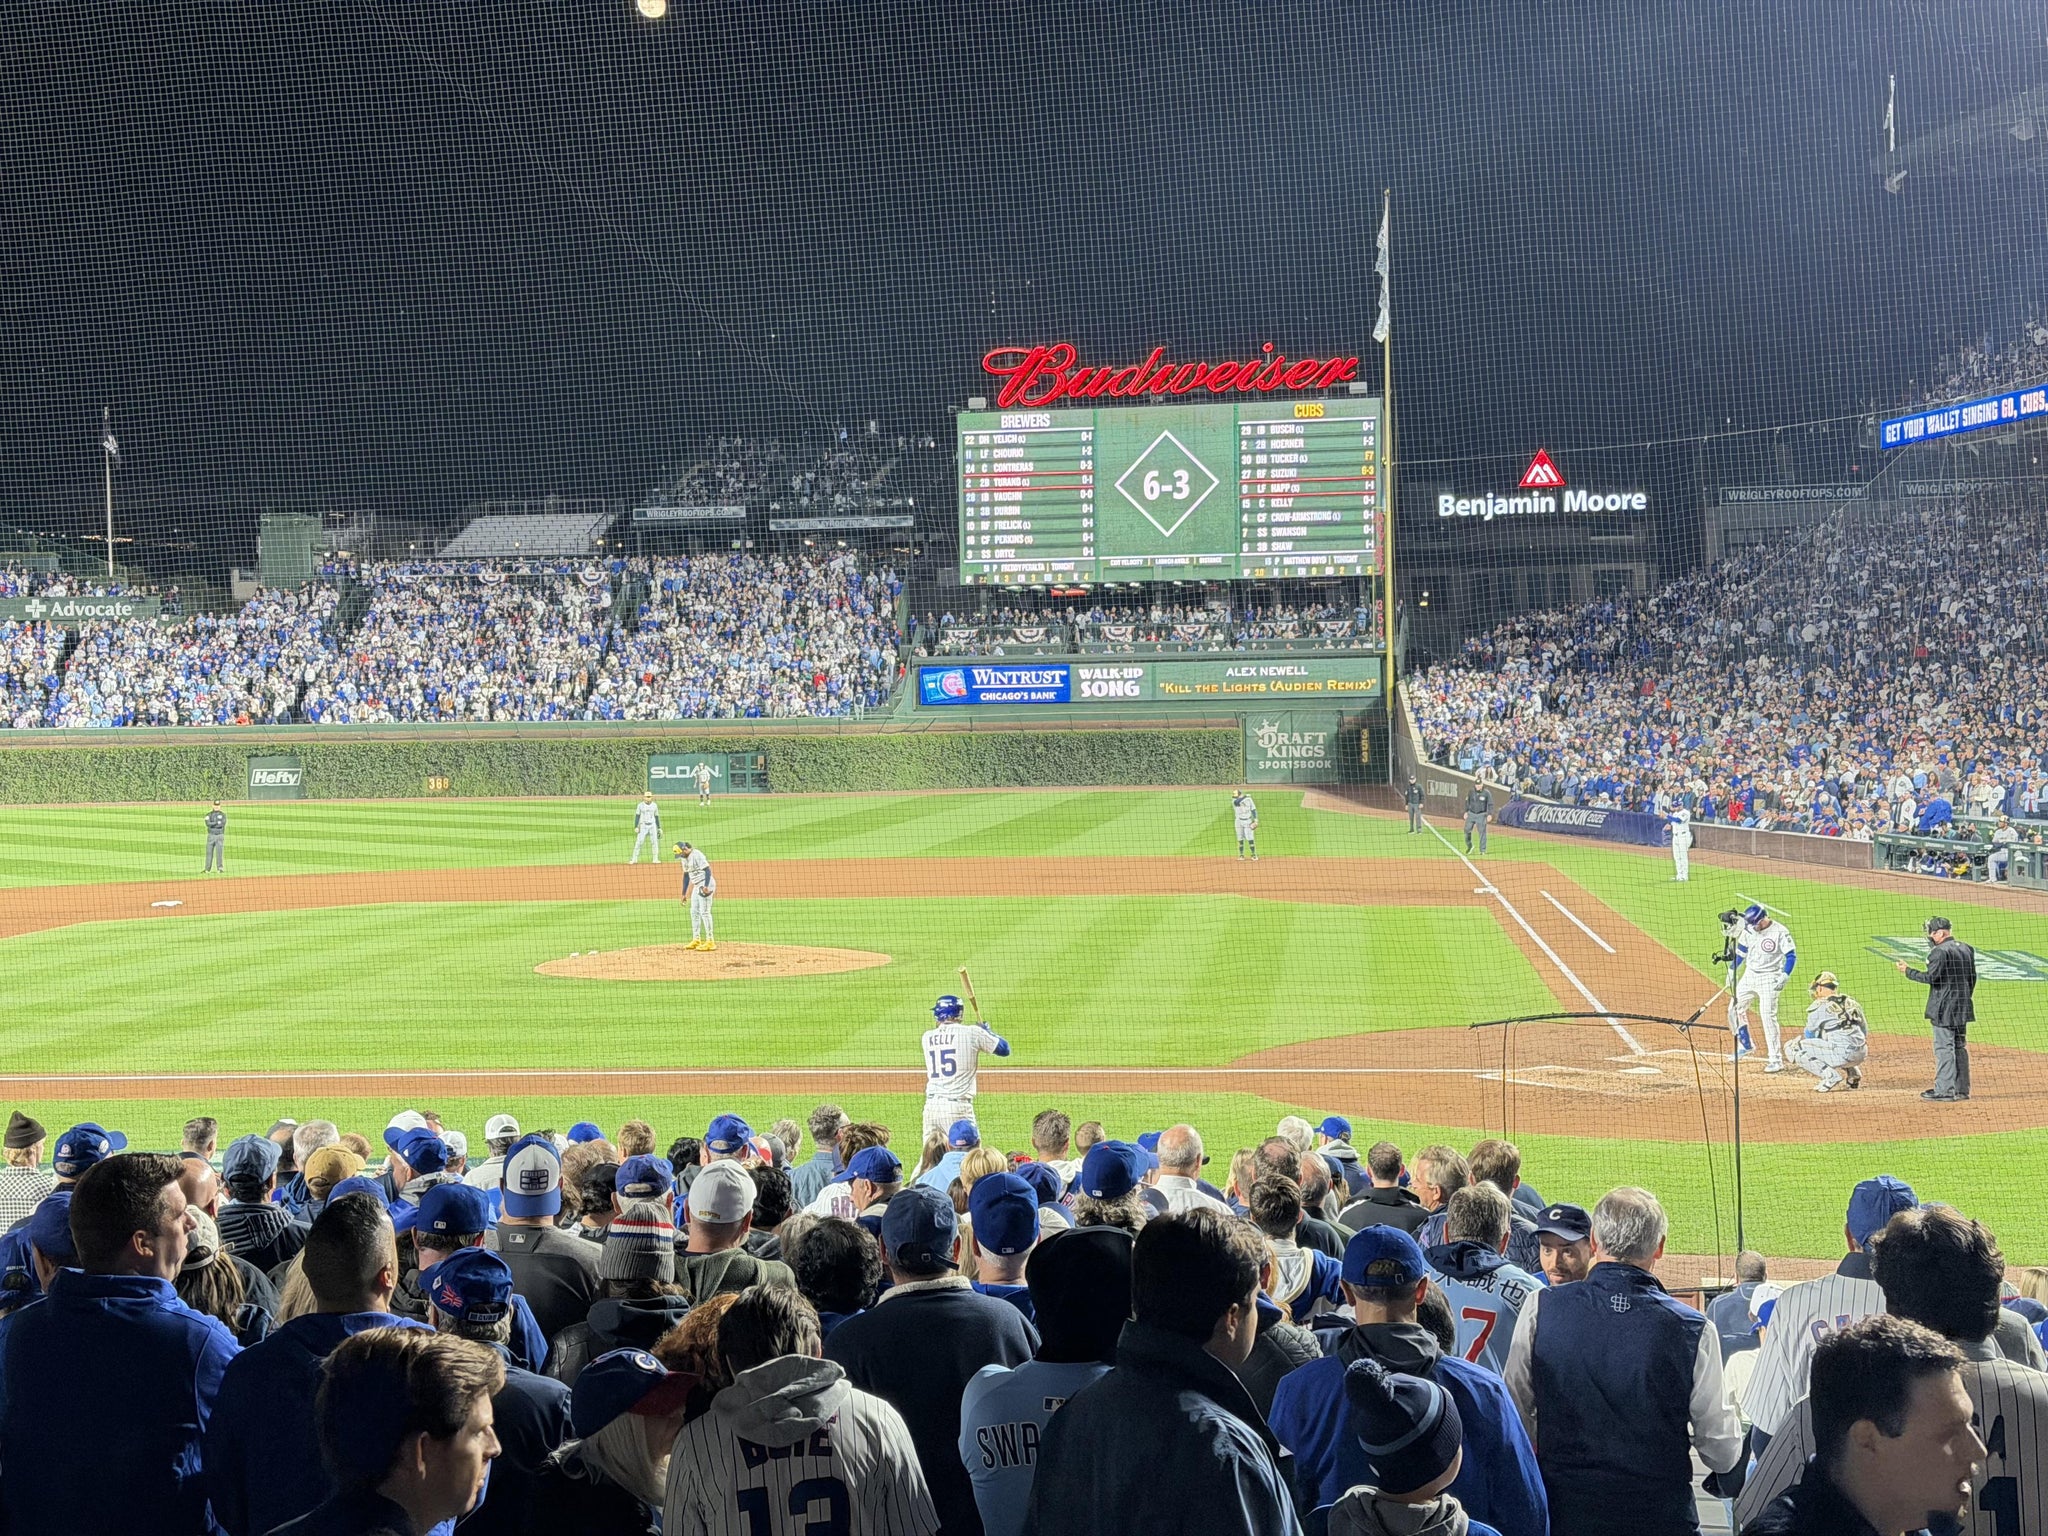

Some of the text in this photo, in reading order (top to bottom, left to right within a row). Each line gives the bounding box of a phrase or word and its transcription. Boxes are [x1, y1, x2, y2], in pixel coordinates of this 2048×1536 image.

[982, 342, 1359, 408] Budweiser
[1294, 403, 1324, 418] CUBS
[1001, 414, 1050, 428] BREWERS
[1886, 423, 1901, 443] GET
[1903, 418, 1924, 439] YOUR
[1927, 410, 1960, 434] WALLET
[1962, 401, 1998, 427] SINGING
[2001, 398, 2017, 419] GO,
[1241, 426, 1251, 435] 29
[1270, 425, 1295, 434] BUSCH
[1363, 422, 1374, 431] 0-1
[965, 436, 974, 445] 22
[993, 434, 1017, 444] YELICH
[1081, 432, 1092, 441] 0-1
[1241, 441, 1247, 450] 2
[1271, 439, 1304, 449] HOERNER
[1364, 437, 1374, 446] 1-2
[980, 450, 989, 459] LF
[993, 448, 1023, 458] CHOURIO
[1082, 446, 1092, 456] 1-2
[1242, 455, 1251, 464] 30
[1271, 454, 1299, 463] TUCKER
[1365, 451, 1374, 460] F7
[966, 460, 1092, 474] 24 C CONTRERAS 0-2
[1242, 466, 1374, 479] 27 RF SUZUKI 6-3
[966, 479, 971, 488] 2
[980, 478, 989, 487] 2B
[1082, 475, 1092, 484] 0-1
[1144, 469, 1190, 500] 6-3
[1257, 484, 1266, 493] LF
[1271, 484, 1290, 493] HAPP
[1365, 481, 1374, 490] 1-1
[994, 492, 1022, 501] VAUGHN
[1080, 489, 1093, 499] 0-0
[1242, 496, 1374, 509] 15 C KELLY 0-1
[1439, 490, 1647, 521] Benjamin Moore
[966, 507, 974, 517] 21
[980, 507, 990, 516] 3B
[1083, 504, 1093, 513] 0-1
[1242, 514, 1248, 523] 4
[1257, 513, 1267, 523] CF
[1271, 511, 1331, 522] CROW-ARMSTRONG
[1363, 510, 1374, 520] 0-1
[994, 520, 1022, 530] FRELICK
[1083, 518, 1093, 528] 0-1
[1242, 525, 1374, 538] 7 SS SWANSON 0-1
[981, 535, 991, 545] CF
[995, 535, 1024, 544] PERKINS
[1083, 533, 1093, 542] 0-1
[967, 547, 1093, 559] 3 SS ORTIZ 0-1
[1257, 542, 1268, 552] 3B
[1272, 542, 1293, 551] SHAW
[51, 600, 132, 617] Advocate
[972, 669, 1065, 685] WINTRUST
[1079, 668, 1144, 680] WALK-UP
[1226, 666, 1309, 677] ALEX NEWELL
[1081, 681, 1140, 698] SONG
[1194, 684, 1218, 693] THE
[1222, 682, 1266, 693] LIGHTS
[980, 691, 1056, 701] CHICAGO'S BANK
[1258, 732, 1327, 748] DRAFT
[1361, 729, 1369, 763] 353
[1266, 745, 1326, 758] KINGS
[1259, 760, 1332, 770] SPORTSBOOK
[254, 772, 298, 785] Hefty
[428, 778, 449, 790] 368
[1536, 805, 1607, 826] POSTSEASON 2025
[929, 1035, 955, 1047] KELLY
[929, 1049, 957, 1078] 15
[1549, 1209, 1563, 1220] C
[1461, 1306, 1497, 1364] 7
[976, 1422, 1040, 1470] SWA
